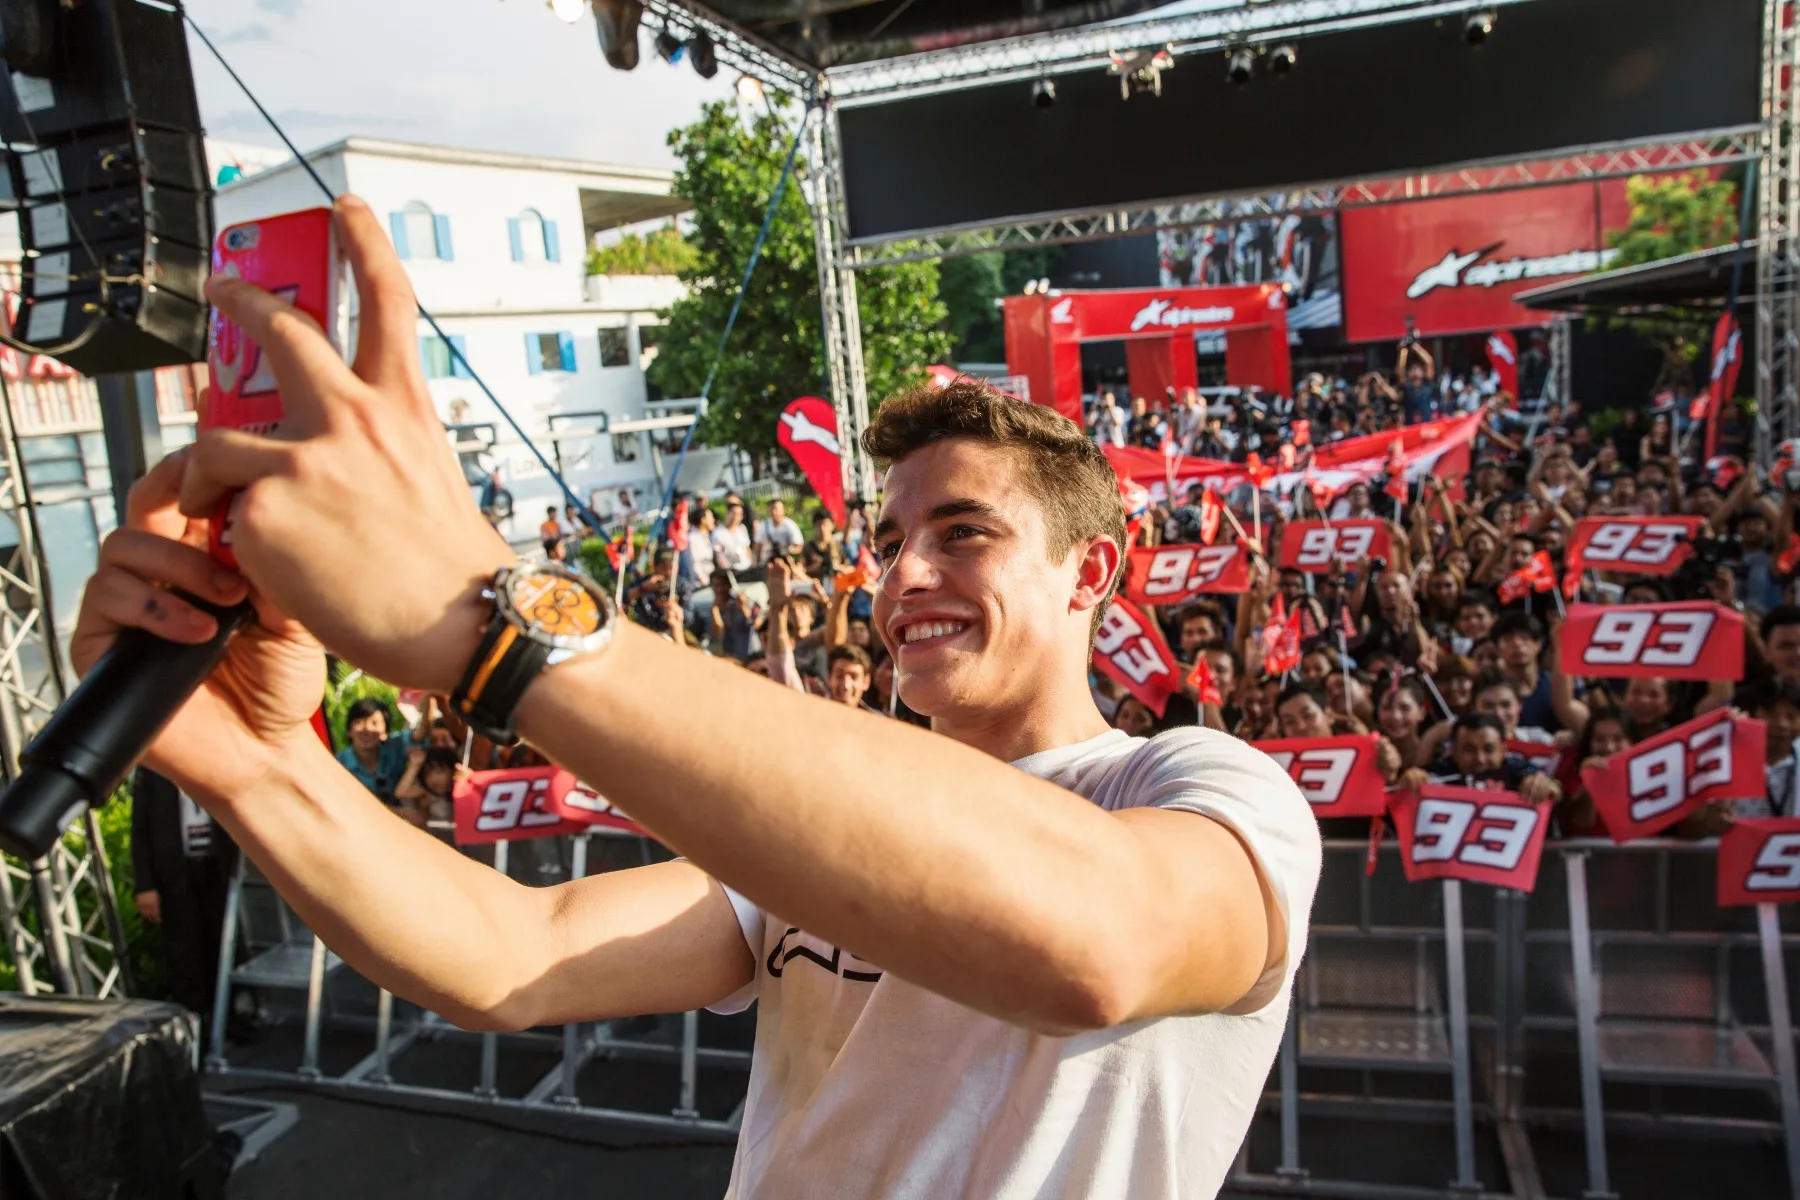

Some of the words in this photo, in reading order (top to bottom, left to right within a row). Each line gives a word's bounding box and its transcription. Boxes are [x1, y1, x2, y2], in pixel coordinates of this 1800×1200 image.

[1144, 545, 1240, 596] 93
[1297, 526, 1376, 565] 93
[1582, 522, 1689, 565] 93
[1094, 602, 1171, 685] 93
[1582, 610, 1716, 667] 93
[1628, 720, 1733, 821] 93
[1411, 798, 1539, 870] 93
